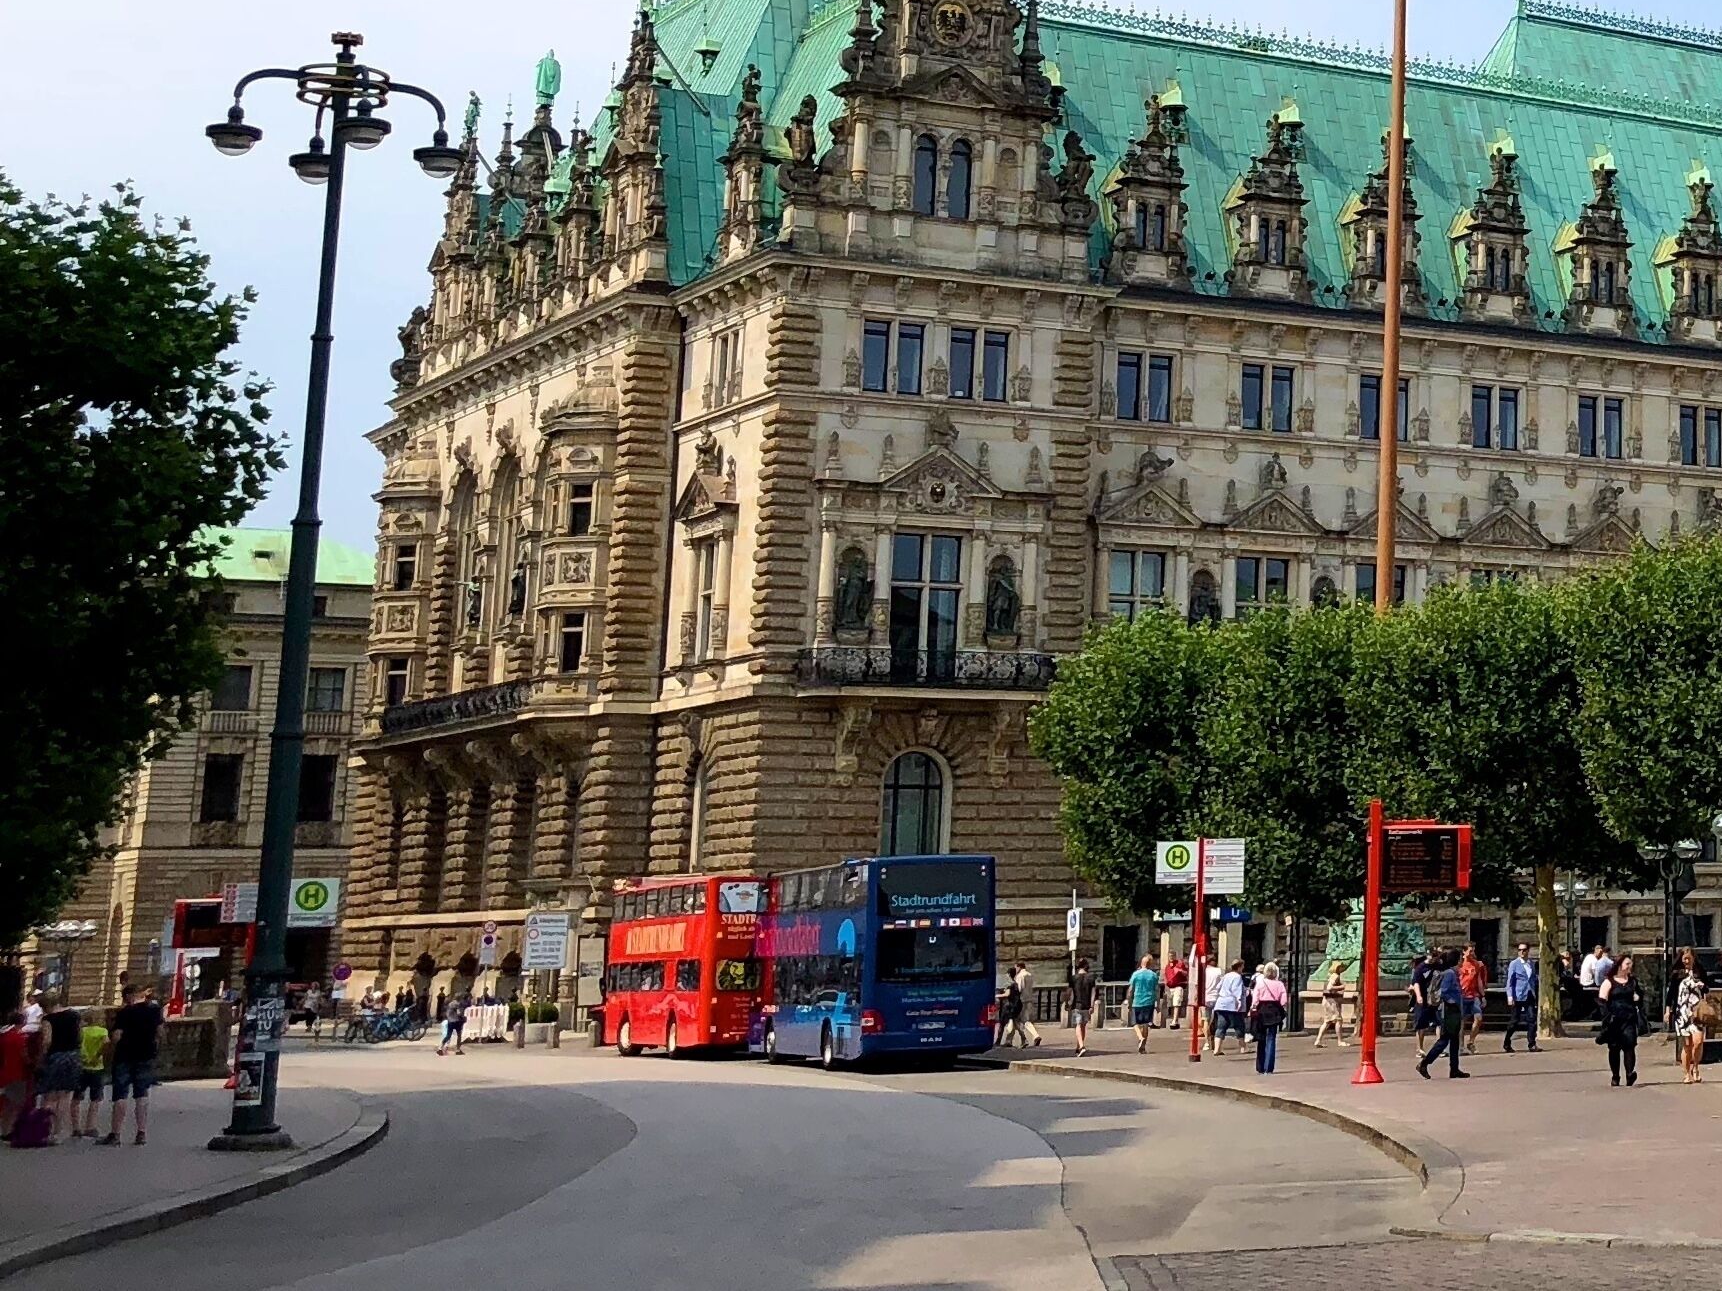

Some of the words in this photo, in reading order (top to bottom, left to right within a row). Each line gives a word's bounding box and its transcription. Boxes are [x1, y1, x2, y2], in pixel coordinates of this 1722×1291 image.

[1172, 850, 1184, 864] H
[304, 888, 319, 904] H
[891, 892, 976, 907] Stadtrundfahrt
